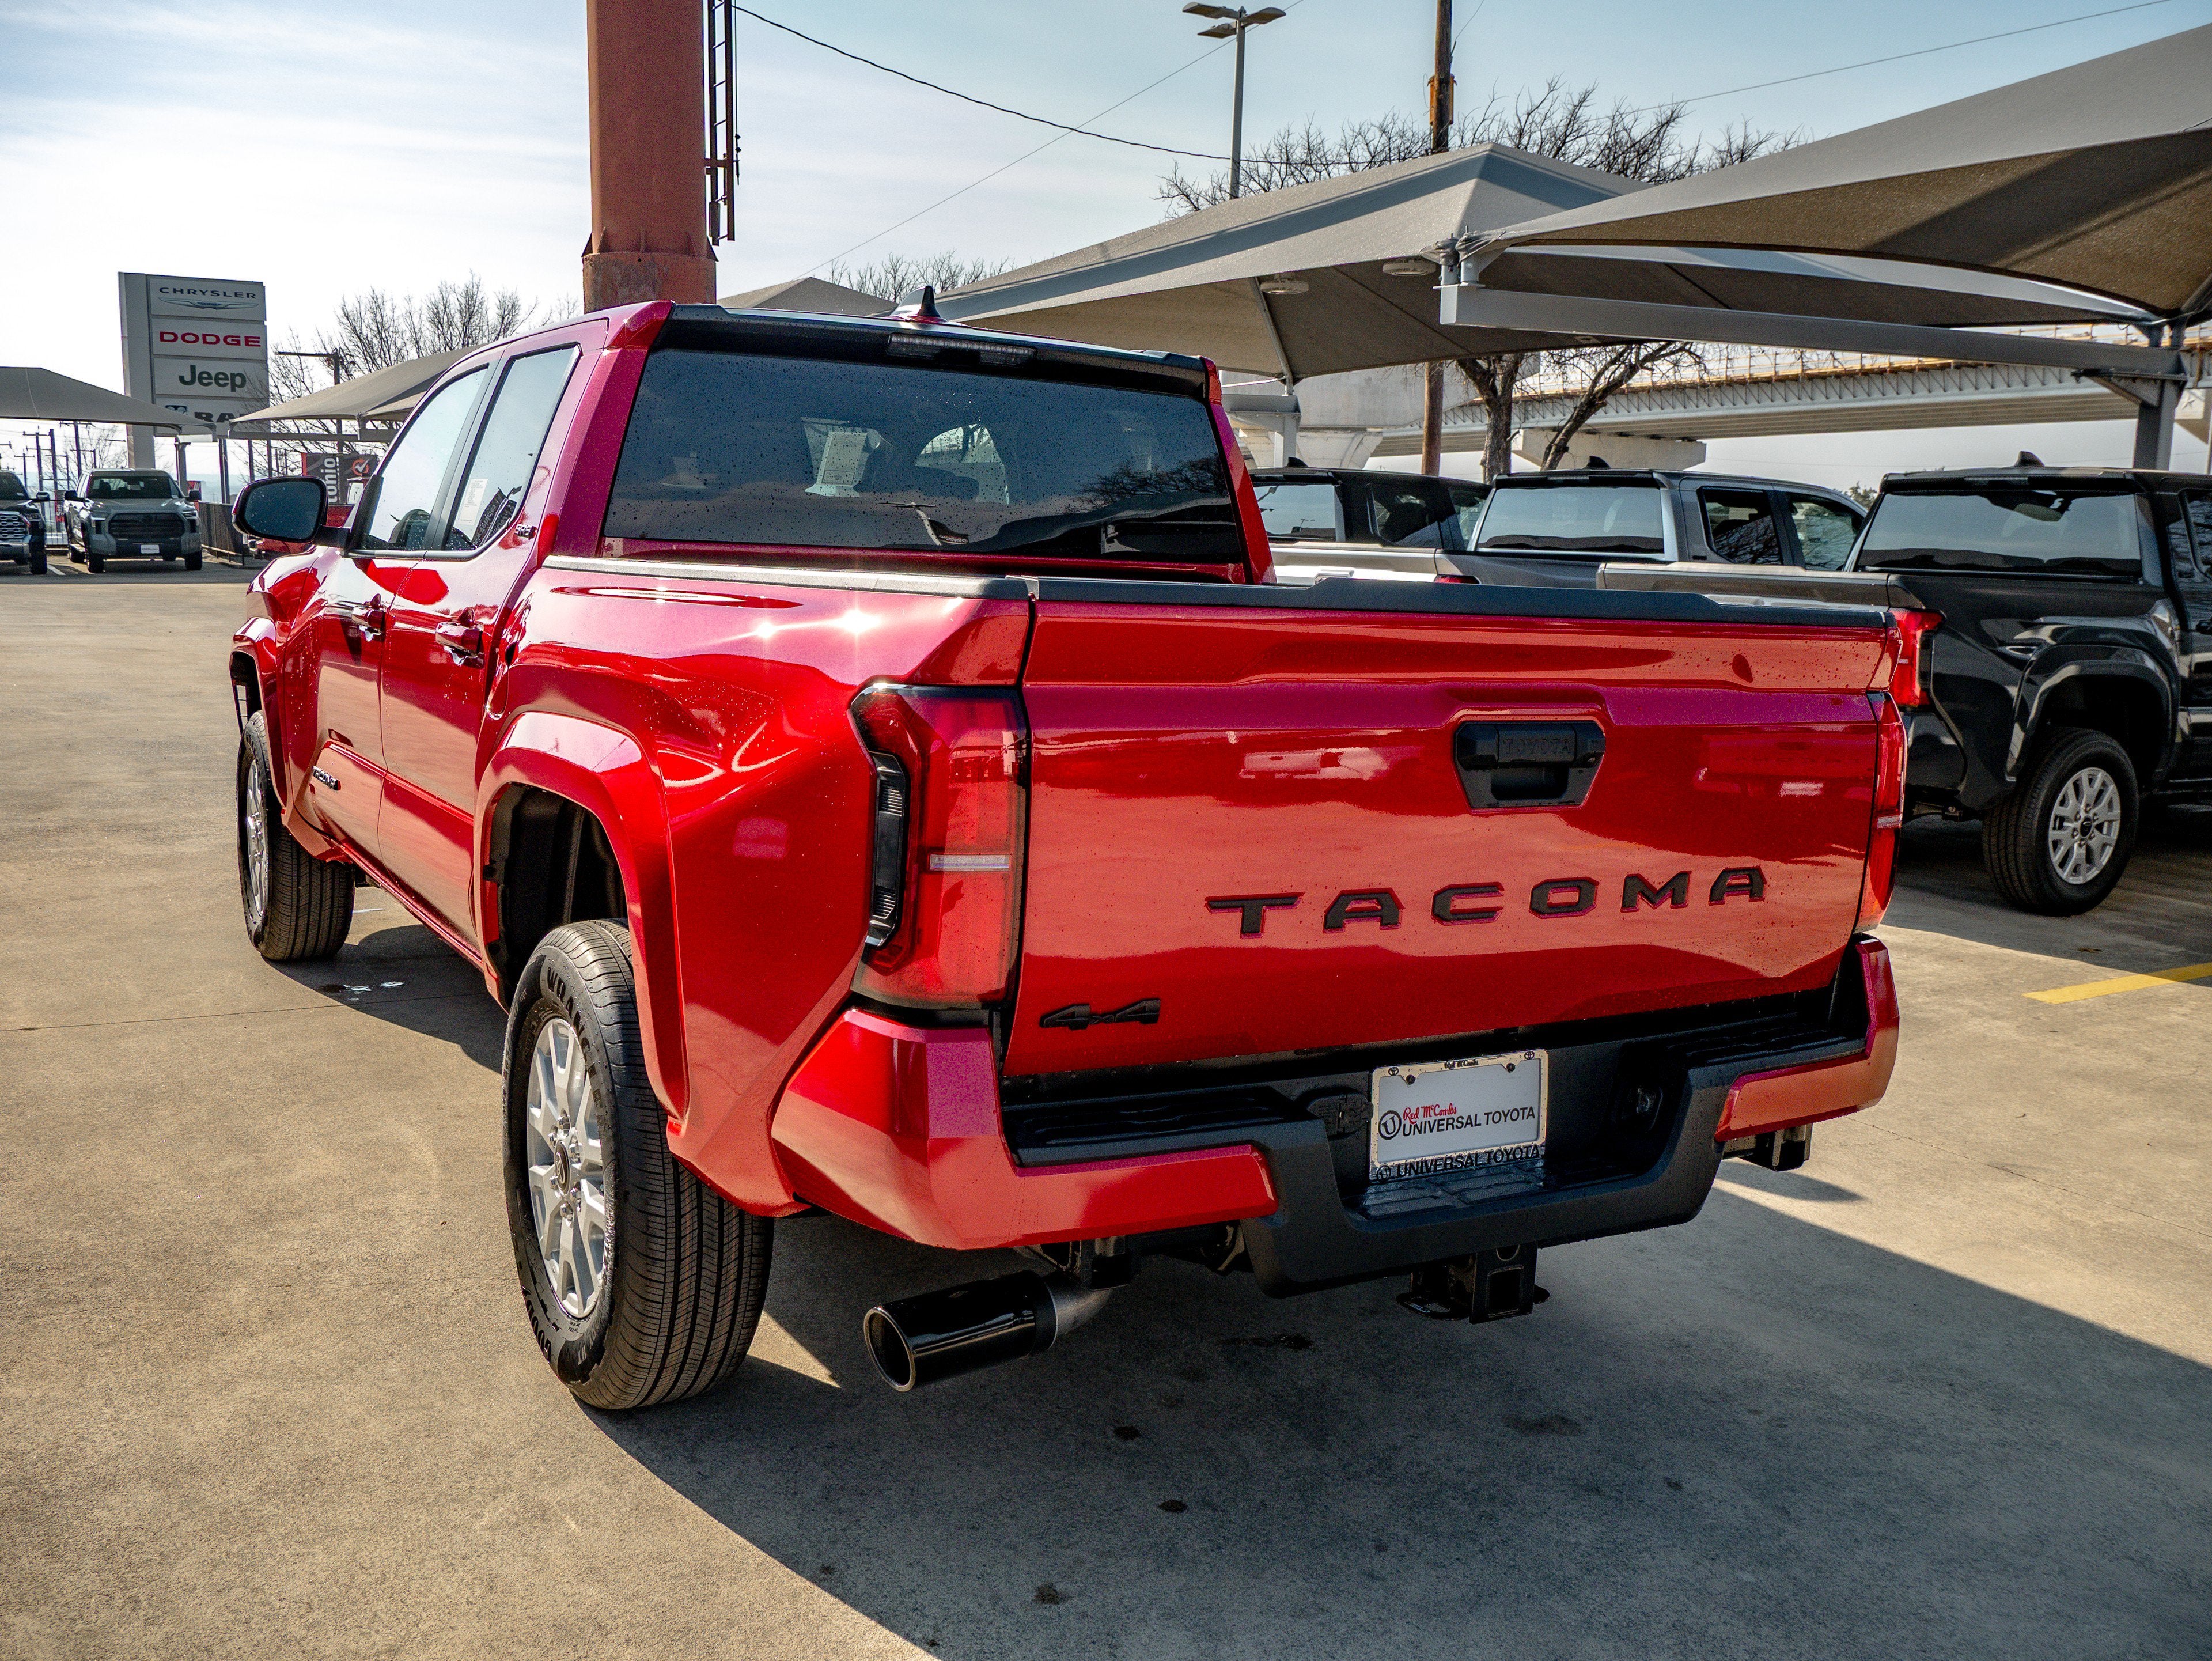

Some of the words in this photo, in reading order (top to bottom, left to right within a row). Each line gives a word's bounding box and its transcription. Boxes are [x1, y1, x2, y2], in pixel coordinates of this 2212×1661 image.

[159, 287, 256, 299] CHRYSLER
[160, 331, 261, 347] DODGE
[179, 365, 247, 392] Jeep
[194, 411, 250, 423] RA
[1502, 738, 1571, 755] TOYOTA
[1203, 864, 1767, 939] TACOMA
[1403, 1107, 1420, 1124] Red
[1421, 1103, 1457, 1118] McCombs
[1403, 1114, 1482, 1137] UNIVERSAL
[1484, 1106, 1535, 1125] TOYOTA
[1397, 1152, 1482, 1176] UNIVERSAL
[1484, 1144, 1540, 1164] TOYOTA
